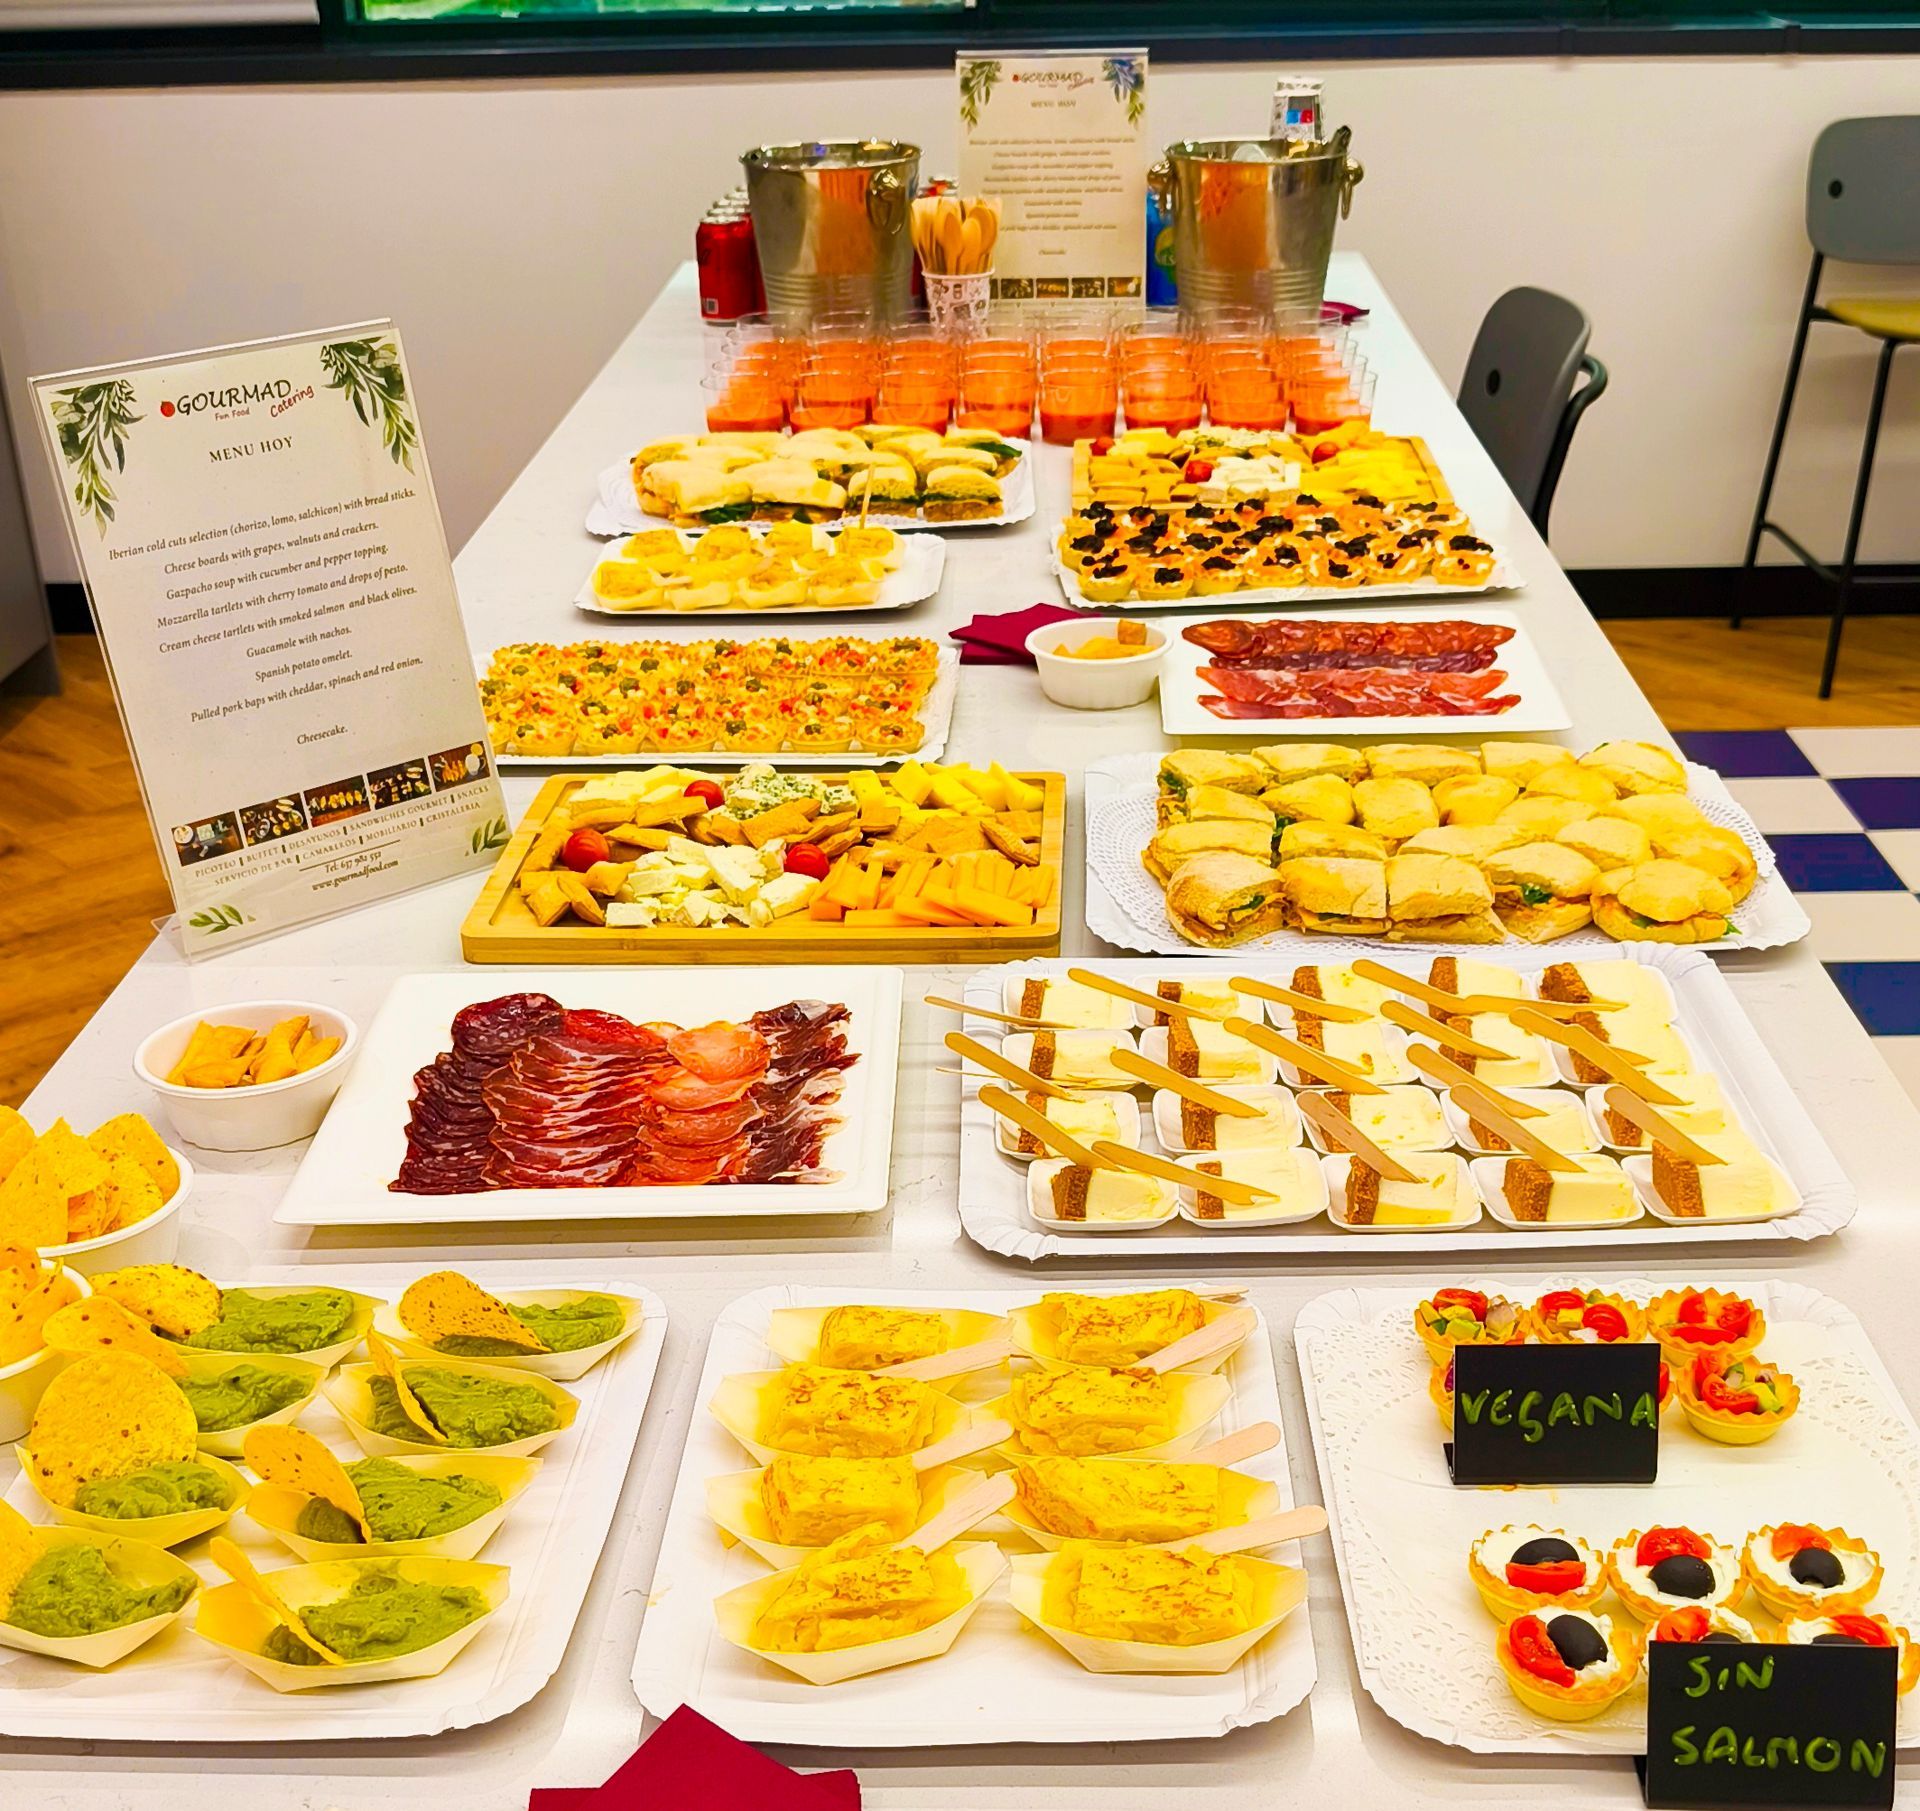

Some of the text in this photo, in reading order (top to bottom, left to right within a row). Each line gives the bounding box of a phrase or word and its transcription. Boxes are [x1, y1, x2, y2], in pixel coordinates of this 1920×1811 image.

[177, 379, 315, 418] GOURMAD Catering
[215, 407, 250, 421] Fun Food
[209, 436, 293, 463] MENU HOY
[109, 488, 416, 560] Iberian cold cuts selection (chorizo, lomo, salchicon) with bread sticks.
[164, 521, 379, 574] Cheese boards with grapes, walnuts and crackers.
[157, 564, 408, 628] Mozzarella tartlets with cherry tomato and drops of pesto.
[166, 544, 389, 600] Gazpacho soup with cucumber and pepper topping.
[159, 585, 418, 654] Cream cheese tartlets with smoked salmon and black olives.
[246, 626, 352, 658] Guacamole with nachos.
[191, 657, 423, 722] Pulled pork baps with cheddar, spinach and red onion.
[255, 650, 353, 682] Spanish potato omelet.
[297, 725, 349, 745] Cheesecake.
[195, 785, 489, 878] PICOTEO BUFFET DESAYUNOS SANDWICHES GOURMET SNACKS
[214, 867, 258, 886] SERVICIO
[261, 863, 273, 873] DE
[275, 857, 293, 868] BAR
[303, 838, 356, 860] CAMAREROS
[366, 820, 417, 841] MOBILIARIO
[312, 860, 399, 890] www.gourmadfood.com
[1461, 1389, 1657, 1444] VEGANA
[1672, 1726, 1886, 1779] SALMON
